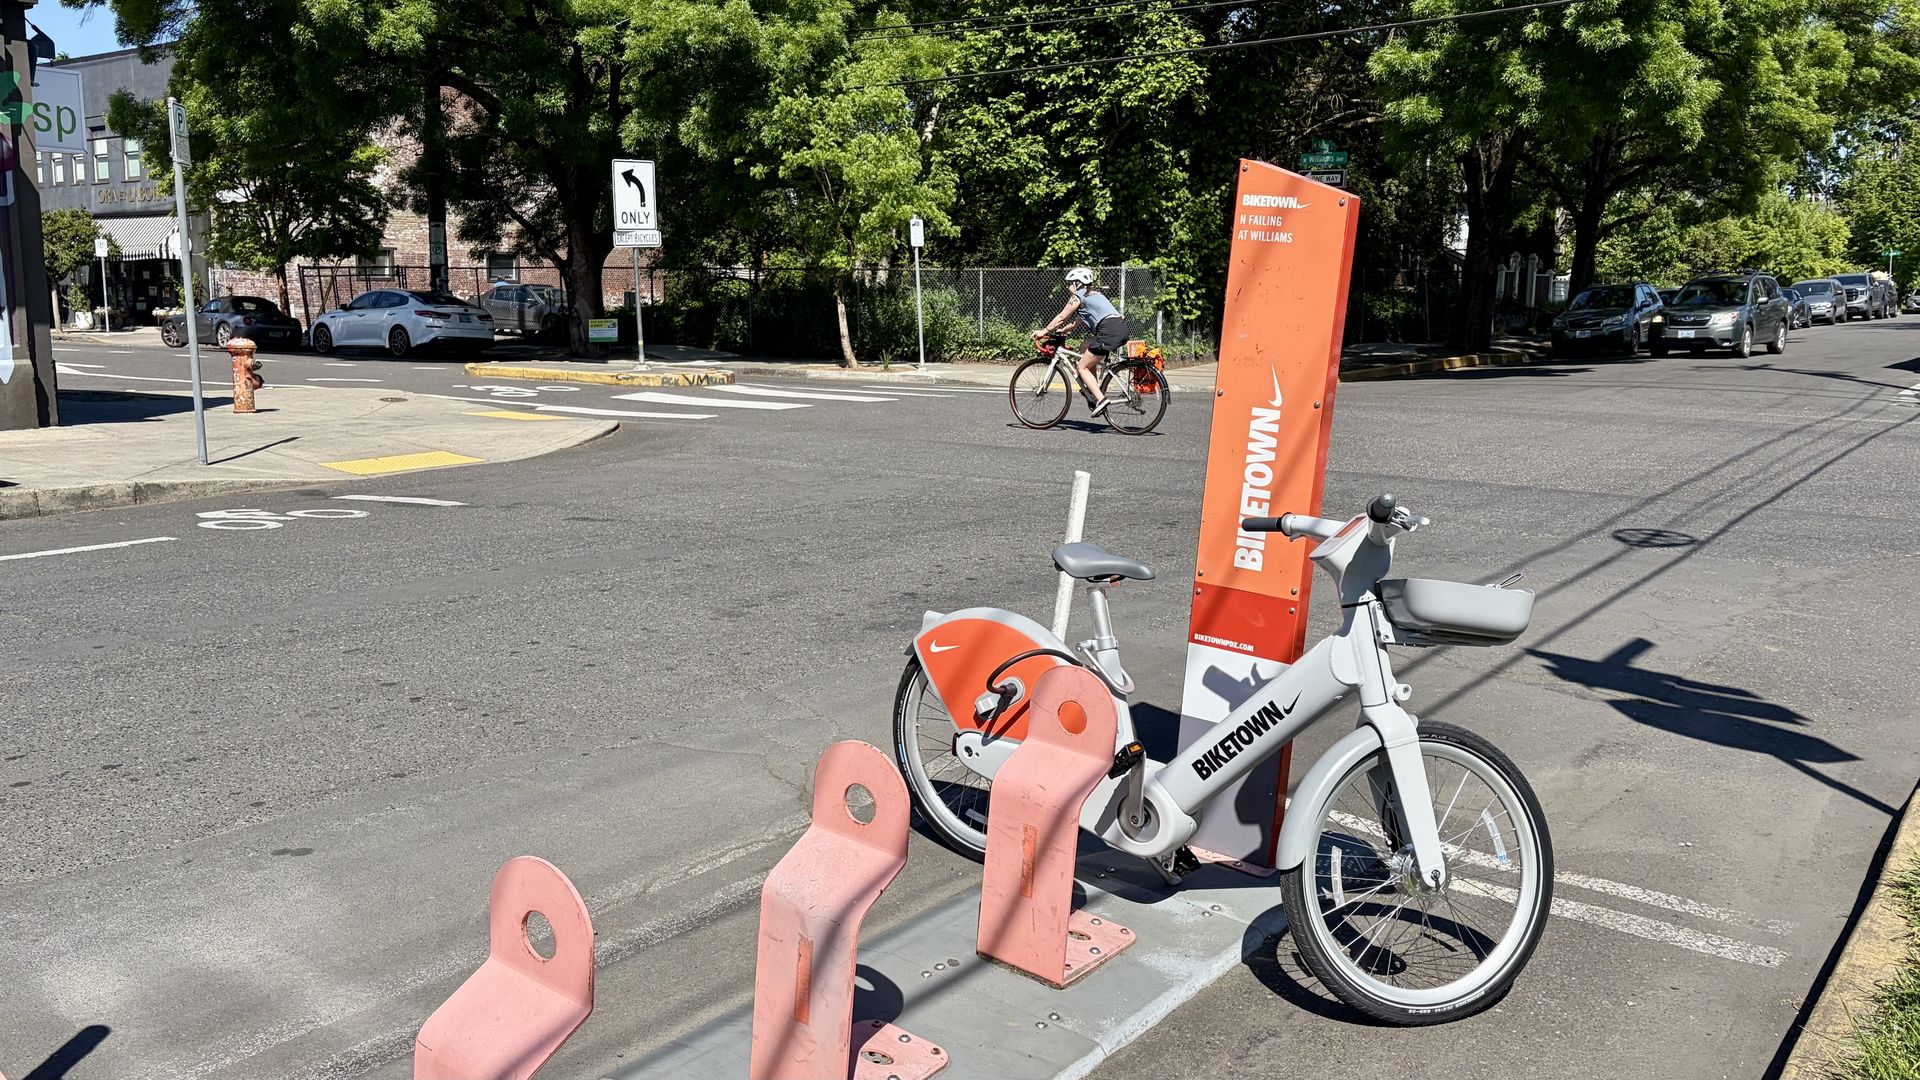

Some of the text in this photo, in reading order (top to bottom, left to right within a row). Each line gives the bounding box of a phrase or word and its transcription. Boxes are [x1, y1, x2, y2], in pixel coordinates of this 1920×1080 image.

[128, 186, 167, 203] LABOR
[1242, 194, 1298, 209] BIKETOWN
[621, 211, 650, 224] ONLY
[1240, 214, 1283, 227] N FAILING
[616, 233, 658, 243] EXCEPT BICYCLES
[1238, 229, 1293, 244] AT WILLIAMS
[1194, 632, 1254, 652] BIKETOWNPDX.COM
[1191, 700, 1286, 781] BIKETOWN
